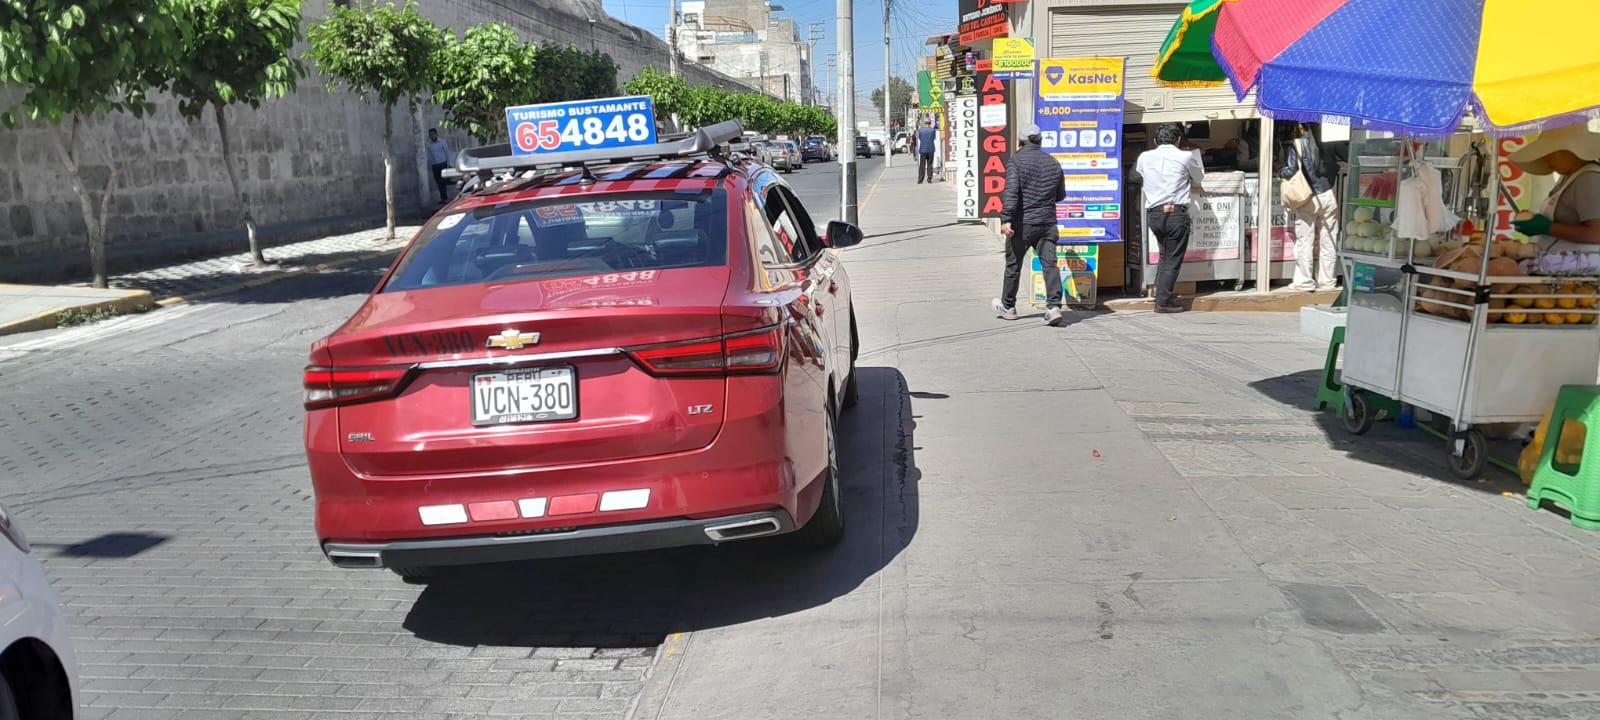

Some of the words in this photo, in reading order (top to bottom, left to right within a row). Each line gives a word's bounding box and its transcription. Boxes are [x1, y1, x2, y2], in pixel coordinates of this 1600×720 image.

[1068, 73, 1118, 84] KasNet
[512, 110, 565, 121] TURISMO
[568, 101, 647, 117] BUSTAMANTE
[515, 113, 650, 152] 654848
[963, 98, 975, 217] CONCILIACION
[1216, 202, 1231, 210] DNI
[479, 382, 571, 415] VCN-380
[687, 404, 713, 415] LTZ
